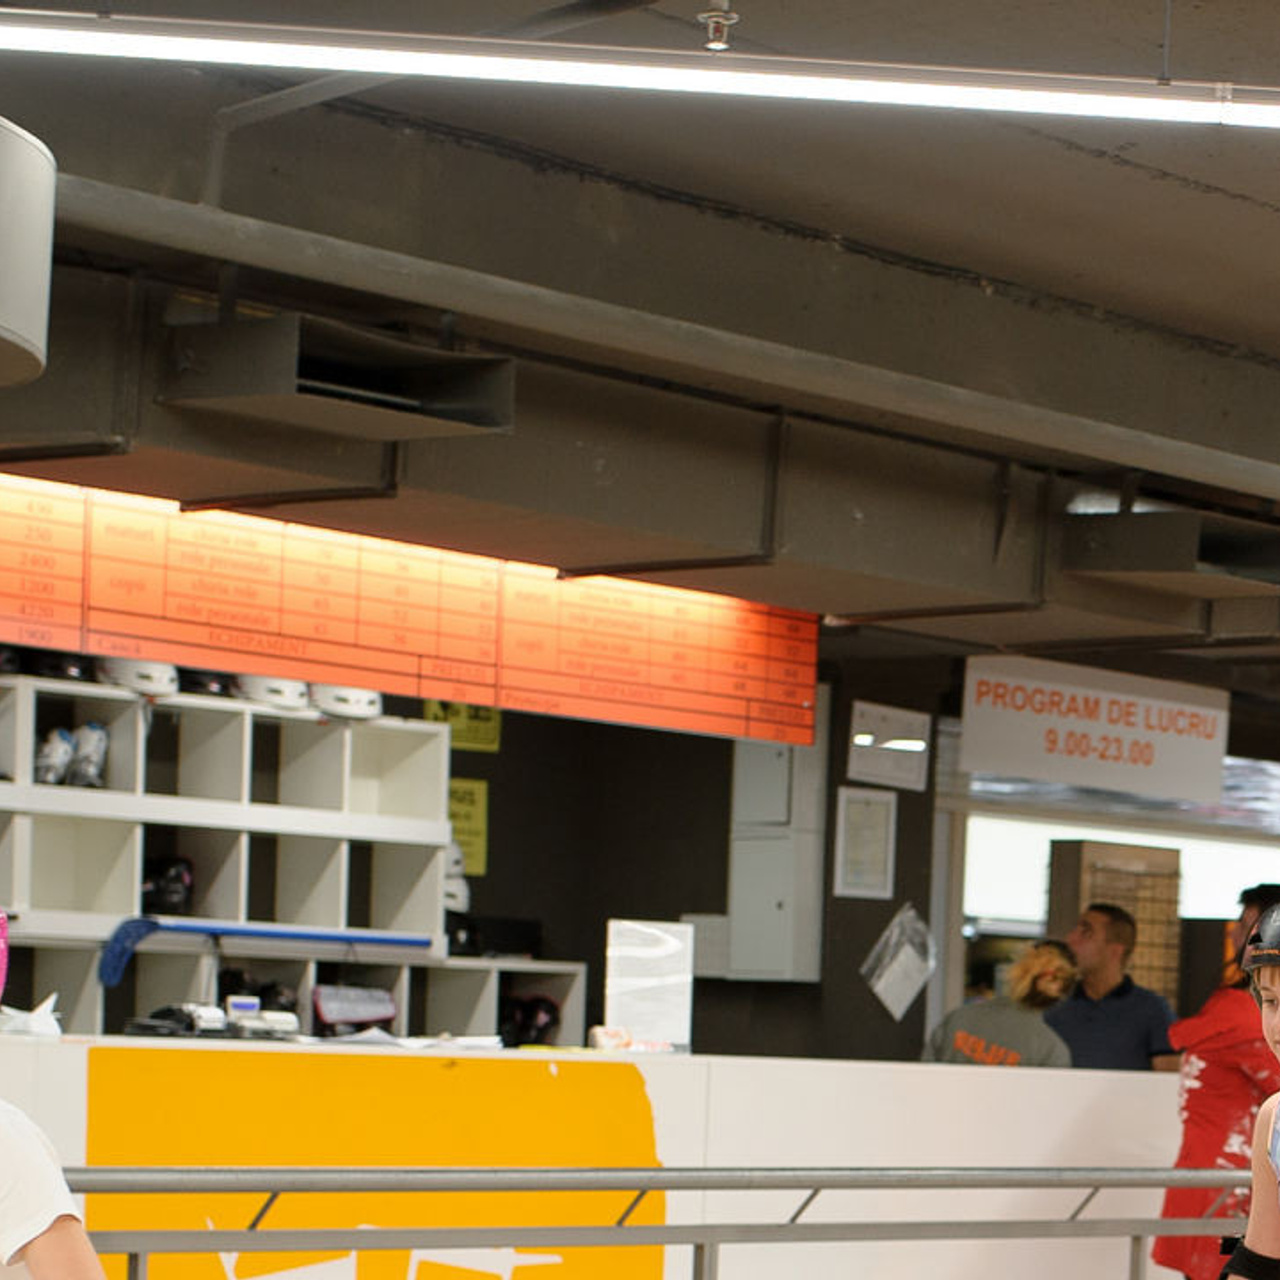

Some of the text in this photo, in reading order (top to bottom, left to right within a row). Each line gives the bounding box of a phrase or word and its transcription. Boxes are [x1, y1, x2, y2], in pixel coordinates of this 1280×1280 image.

[974, 679, 1217, 741] PROGRAM DE LUCRU
[1043, 728, 1155, 767] 9.00-23.00
